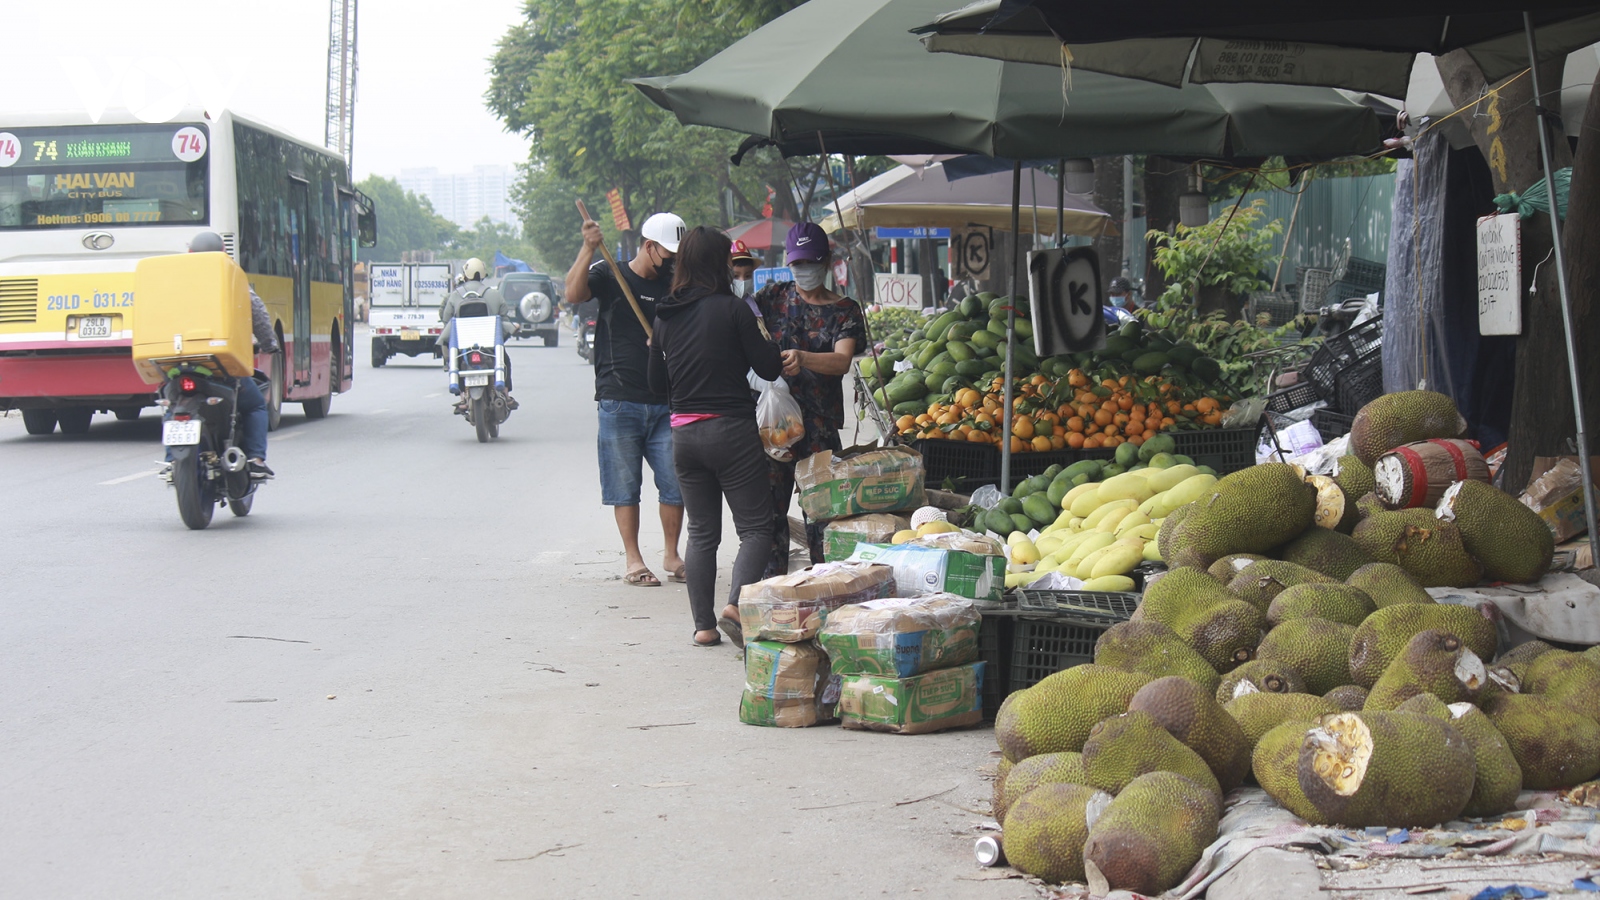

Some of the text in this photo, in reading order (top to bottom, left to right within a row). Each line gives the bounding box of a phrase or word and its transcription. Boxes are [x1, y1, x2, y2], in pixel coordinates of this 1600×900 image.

[33, 140, 58, 160] 74
[178, 134, 201, 153] 74
[93, 172, 135, 188] VAN
[98, 190, 122, 198] BUS
[84, 213, 112, 224] 0906
[116, 212, 130, 222] 00
[133, 212, 161, 222] 7777
[881, 279, 918, 305] 10K
[47, 295, 80, 310] 29LD
[86, 318, 104, 327] 29LD
[83, 327, 107, 336] 031.29
